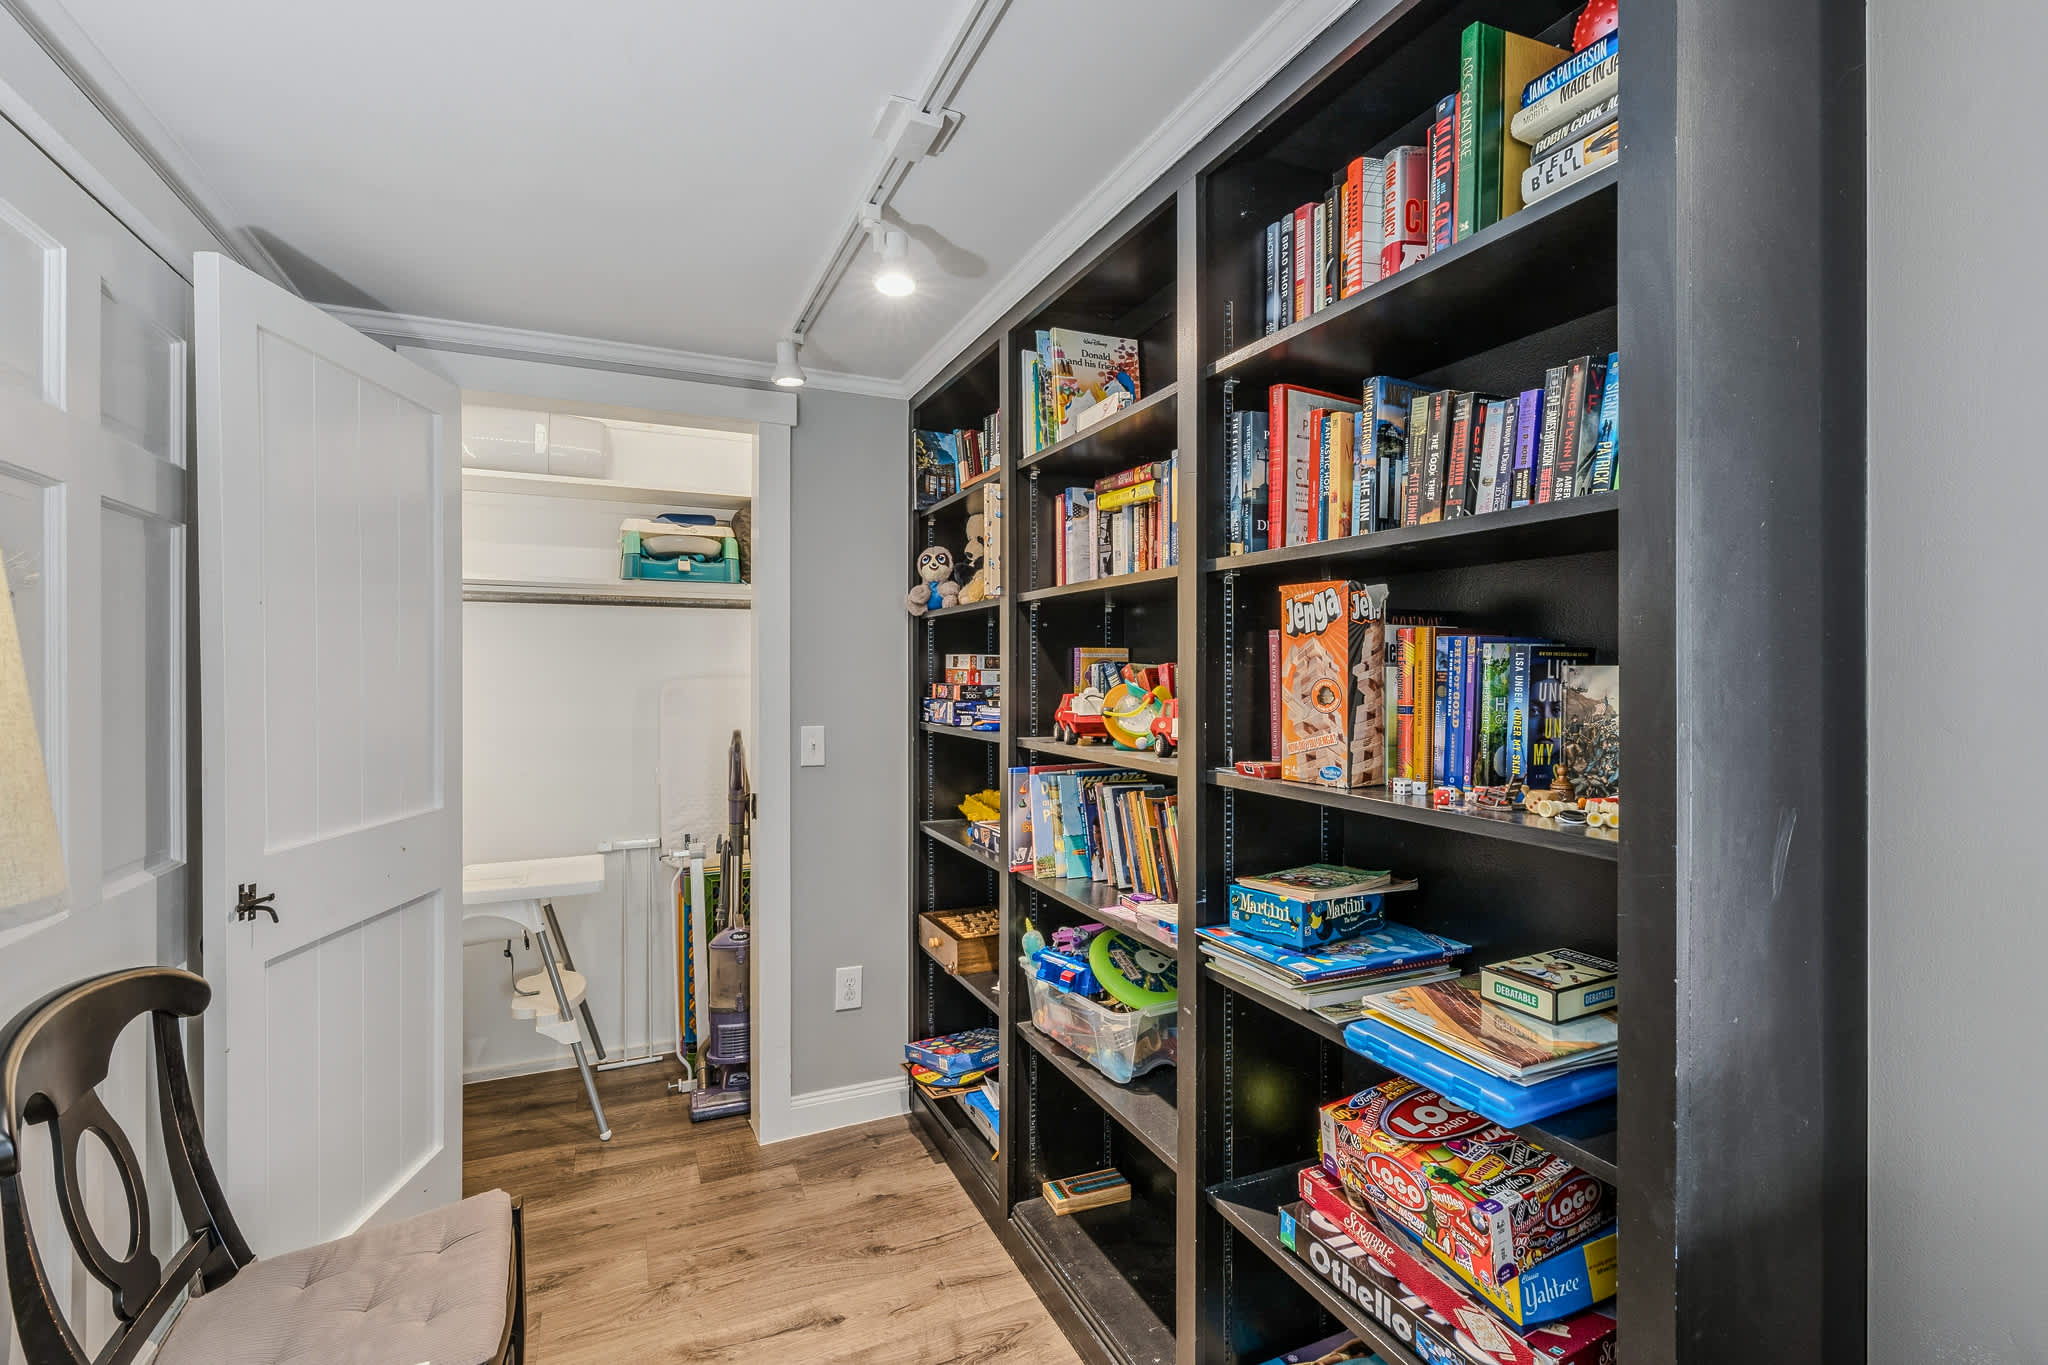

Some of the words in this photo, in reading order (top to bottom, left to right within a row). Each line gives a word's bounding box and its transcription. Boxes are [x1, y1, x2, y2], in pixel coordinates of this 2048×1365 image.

[1527, 72, 1556, 103] JAMES
[1556, 39, 1608, 85] PATTERSON
[1560, 74, 1591, 104] MADE
[1592, 63, 1606, 87] IN
[1461, 107, 1473, 160] NATURE
[1535, 123, 1570, 156] ROBIN
[1570, 108, 1603, 133] COOK
[1435, 115, 1452, 178] MIND
[1385, 160, 1397, 188] TOM
[1531, 156, 1582, 192] BELL
[1537, 147, 1574, 175] TED
[1384, 191, 1397, 239] CLANCY
[1436, 201, 1451, 246] GAM
[1281, 235, 1289, 266] BRAD
[1281, 268, 1289, 299] THOR
[1068, 358, 1083, 367] and
[1084, 360, 1097, 369] his
[1098, 361, 1124, 371] friend
[1081, 350, 1111, 361] Donald
[1363, 384, 1375, 411] JAMES
[1567, 381, 1579, 418] VINCE
[1232, 418, 1240, 434] THE
[1361, 411, 1373, 455] PATTERSON
[1563, 421, 1575, 458] FLYNN
[1323, 422, 1331, 469] FANTASTIC
[1430, 433, 1440, 450] THE
[1542, 430, 1555, 466] PATTERSON
[1593, 441, 1613, 484] PATRICK
[1360, 472, 1371, 497] THE
[1409, 473, 1420, 493] KITE
[1562, 476, 1573, 498] AMER
[1360, 498, 1371, 521] INN
[1407, 495, 1419, 525] RUNNE
[1285, 587, 1341, 635] Jenga
[1453, 639, 1462, 672] SHIP
[1514, 652, 1525, 672] LISA
[1514, 675, 1524, 703] UNGER
[1451, 692, 1461, 729] GOLD
[1513, 709, 1522, 736] UNDER
[1512, 739, 1522, 750] MY
[1533, 743, 1554, 765] MY
[1512, 754, 1521, 775] SKIN
[1238, 892, 1291, 922] Martini
[1325, 896, 1366, 920] Martini
[1495, 983, 1537, 1007] DEBATABLE
[1585, 988, 1614, 1005] DEBATABLE
[1355, 1088, 1382, 1106] Ford
[1414, 1092, 1437, 1104] The
[1334, 1107, 1360, 1121] ups
[1428, 1115, 1469, 1137] BOARD
[1465, 1145, 1483, 1159] TACO
[1473, 1148, 1489, 1161] BELL
[1513, 1145, 1526, 1165] NHL
[1371, 1160, 1421, 1204] LOGO
[1470, 1157, 1502, 1180] Denny's
[1486, 1175, 1531, 1195] Stouffer's
[1550, 1184, 1598, 1222] LOGO
[1343, 1211, 1395, 1260] SCRABBLE
[1309, 1241, 1413, 1342] Othello
[1524, 1275, 1579, 1316] Yahtzee
